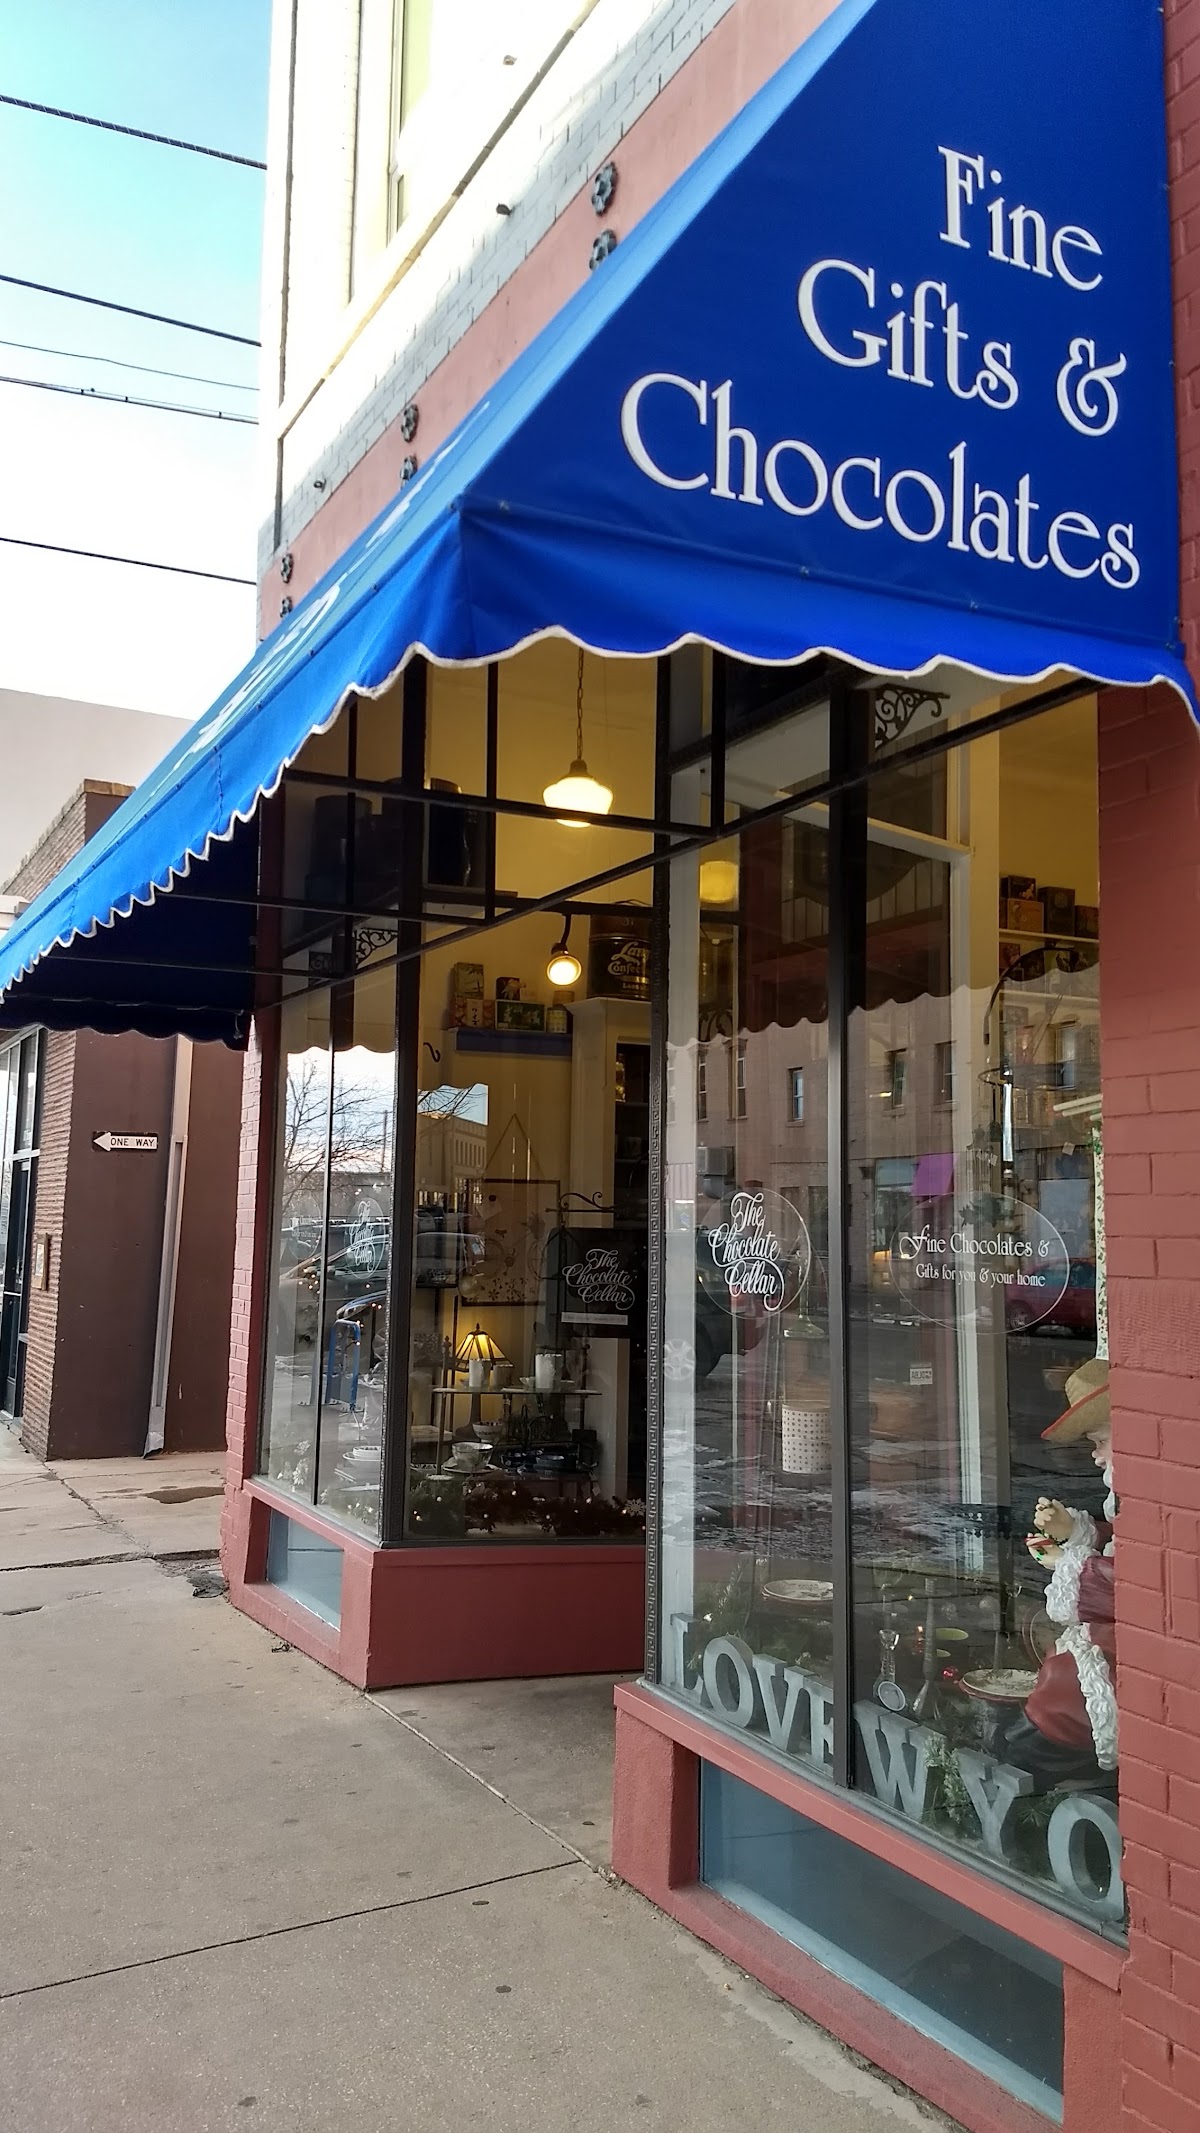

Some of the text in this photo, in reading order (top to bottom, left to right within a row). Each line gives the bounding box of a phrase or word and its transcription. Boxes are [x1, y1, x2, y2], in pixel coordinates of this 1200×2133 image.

[937, 145, 1103, 291] Fine
[797, 258, 1127, 437] Gifts &
[620, 372, 1141, 589] Chocolates
[110, 1137, 155, 1147] ONE WAY
[730, 1192, 766, 1233] The
[585, 1248, 619, 1269] The
[708, 1221, 781, 1268] Chocolate
[950, 1233, 1033, 1257] Chocolates
[1037, 1239, 1050, 1258] &
[562, 1263, 632, 1288] Chocolate
[724, 1258, 785, 1311] Cellar
[916, 1263, 1046, 1288] Gifts for you & your home
[577, 1284, 636, 1311] Cellar
[853, 1700, 1127, 1922] WYO
